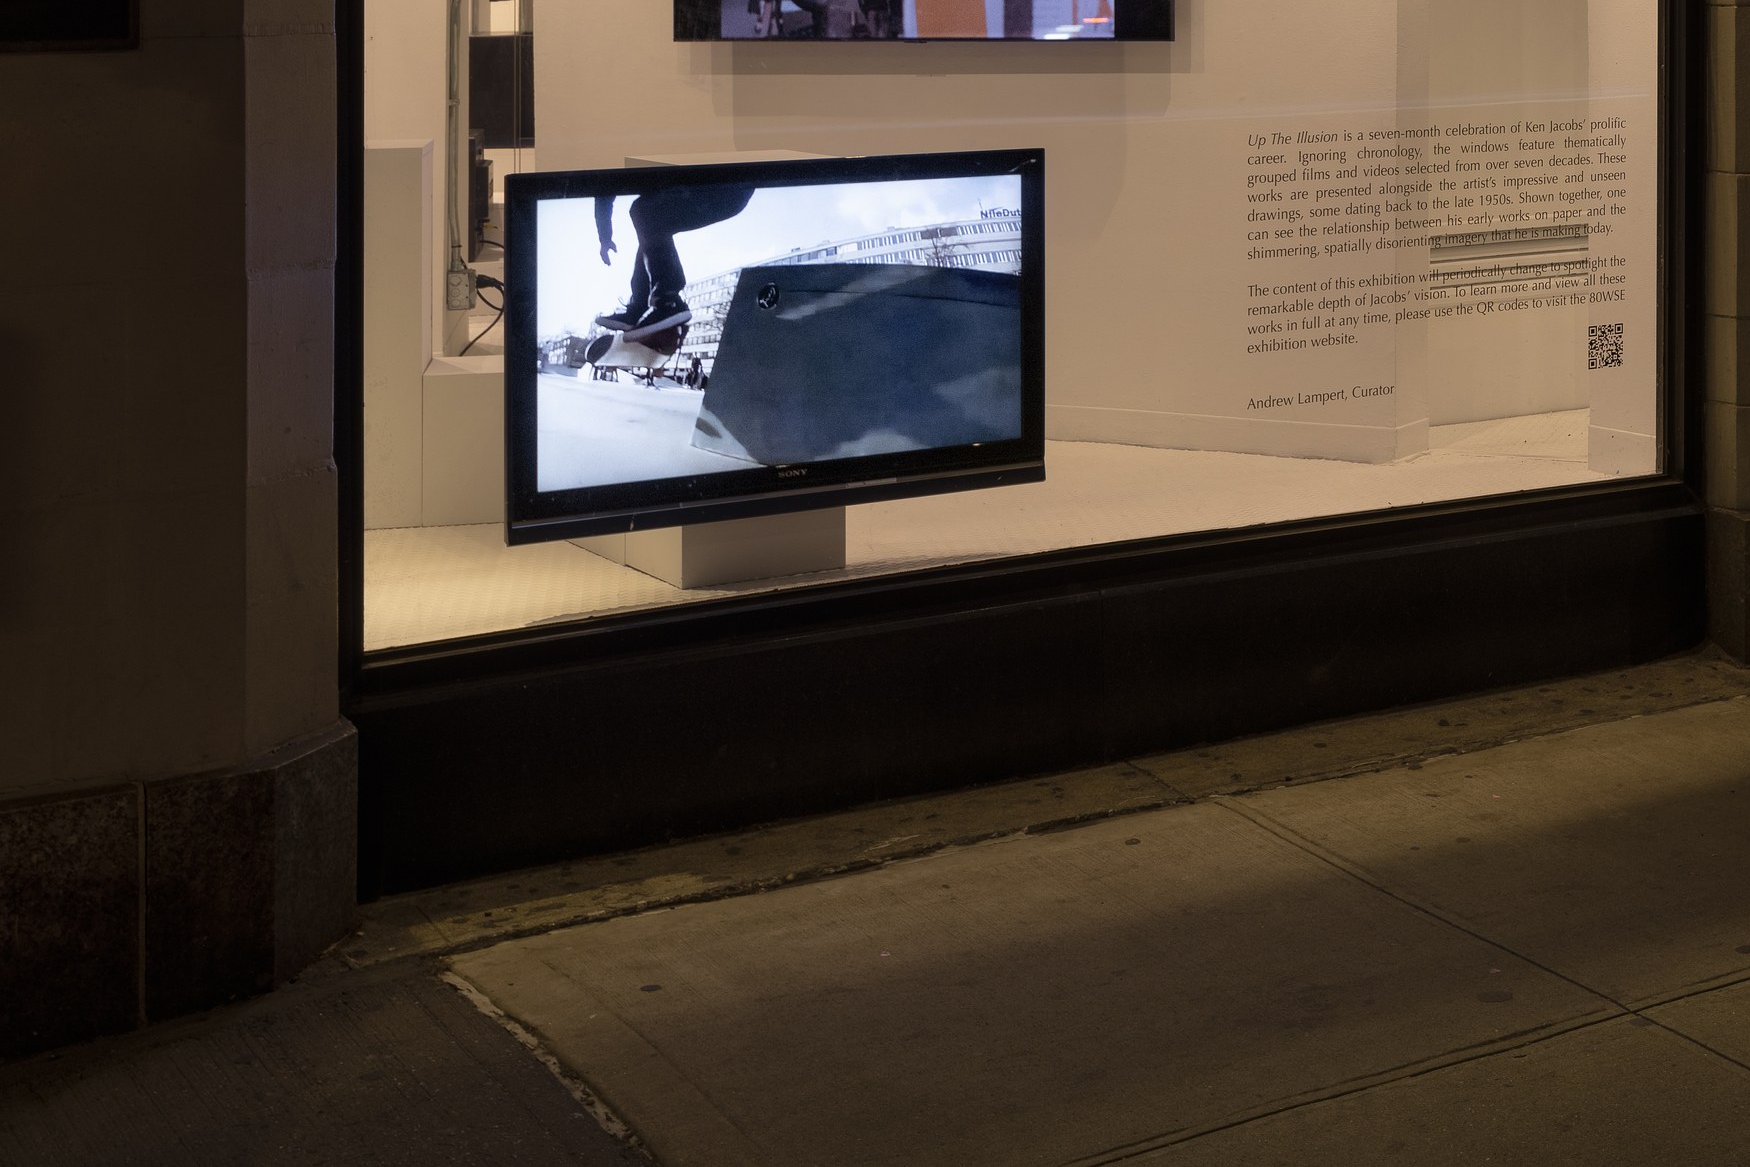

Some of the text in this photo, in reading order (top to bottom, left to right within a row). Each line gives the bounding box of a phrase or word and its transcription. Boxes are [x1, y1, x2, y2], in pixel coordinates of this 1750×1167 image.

[1247, 135, 1626, 166] career. Ignoring chronology, the windows feature thematically
[1248, 134, 1266, 149] Up
[1272, 132, 1291, 145] The
[1297, 130, 1338, 144] Illusion
[1343, 130, 1352, 142] is
[1357, 132, 1363, 141] a
[1368, 125, 1440, 141] seven-month
[1445, 123, 1505, 138] celebration
[1510, 121, 1520, 135] of
[1525, 122, 1545, 134] Ken
[1590, 117, 1626, 135] prolific
[1247, 152, 1626, 188] grouped films and videos selected from over seven decades. These
[1247, 188, 1282, 203] works
[1290, 191, 1308, 200] are
[1316, 183, 1371, 202] presented
[1379, 180, 1432, 197] alongside
[1439, 178, 1456, 192] the
[1503, 173, 1558, 190] impressive
[1564, 170, 1584, 184] and
[1590, 172, 1626, 182] unseen
[1247, 188, 1625, 223] drawings, some dating back to the late 1950s. Shown together, one
[1247, 203, 1625, 241] can see the relationship between his early works on paper and the
[1247, 222, 1613, 259] shimmering, spatially disorienting imagery that he is making today.
[1248, 255, 1625, 297] The content of this exhibition will periodically change to spotlight the
[1247, 298, 1313, 316] remarkable
[1318, 295, 1350, 313] depth
[1354, 294, 1365, 307] of
[1414, 289, 1450, 302] vision.
[1455, 287, 1466, 299] To
[1470, 285, 1496, 298] learn
[1501, 284, 1528, 295] more
[1532, 278, 1551, 292] and
[1555, 278, 1580, 290] view
[1583, 274, 1595, 288] all
[1599, 274, 1625, 287] these
[1247, 290, 1625, 334] works in full at any time, please use the QR codes to visit the 80WSE
[1247, 334, 1358, 353] exhibition website.
[1247, 386, 1394, 409] Andrew Lampert, Curator
[778, 468, 808, 479] SONY
